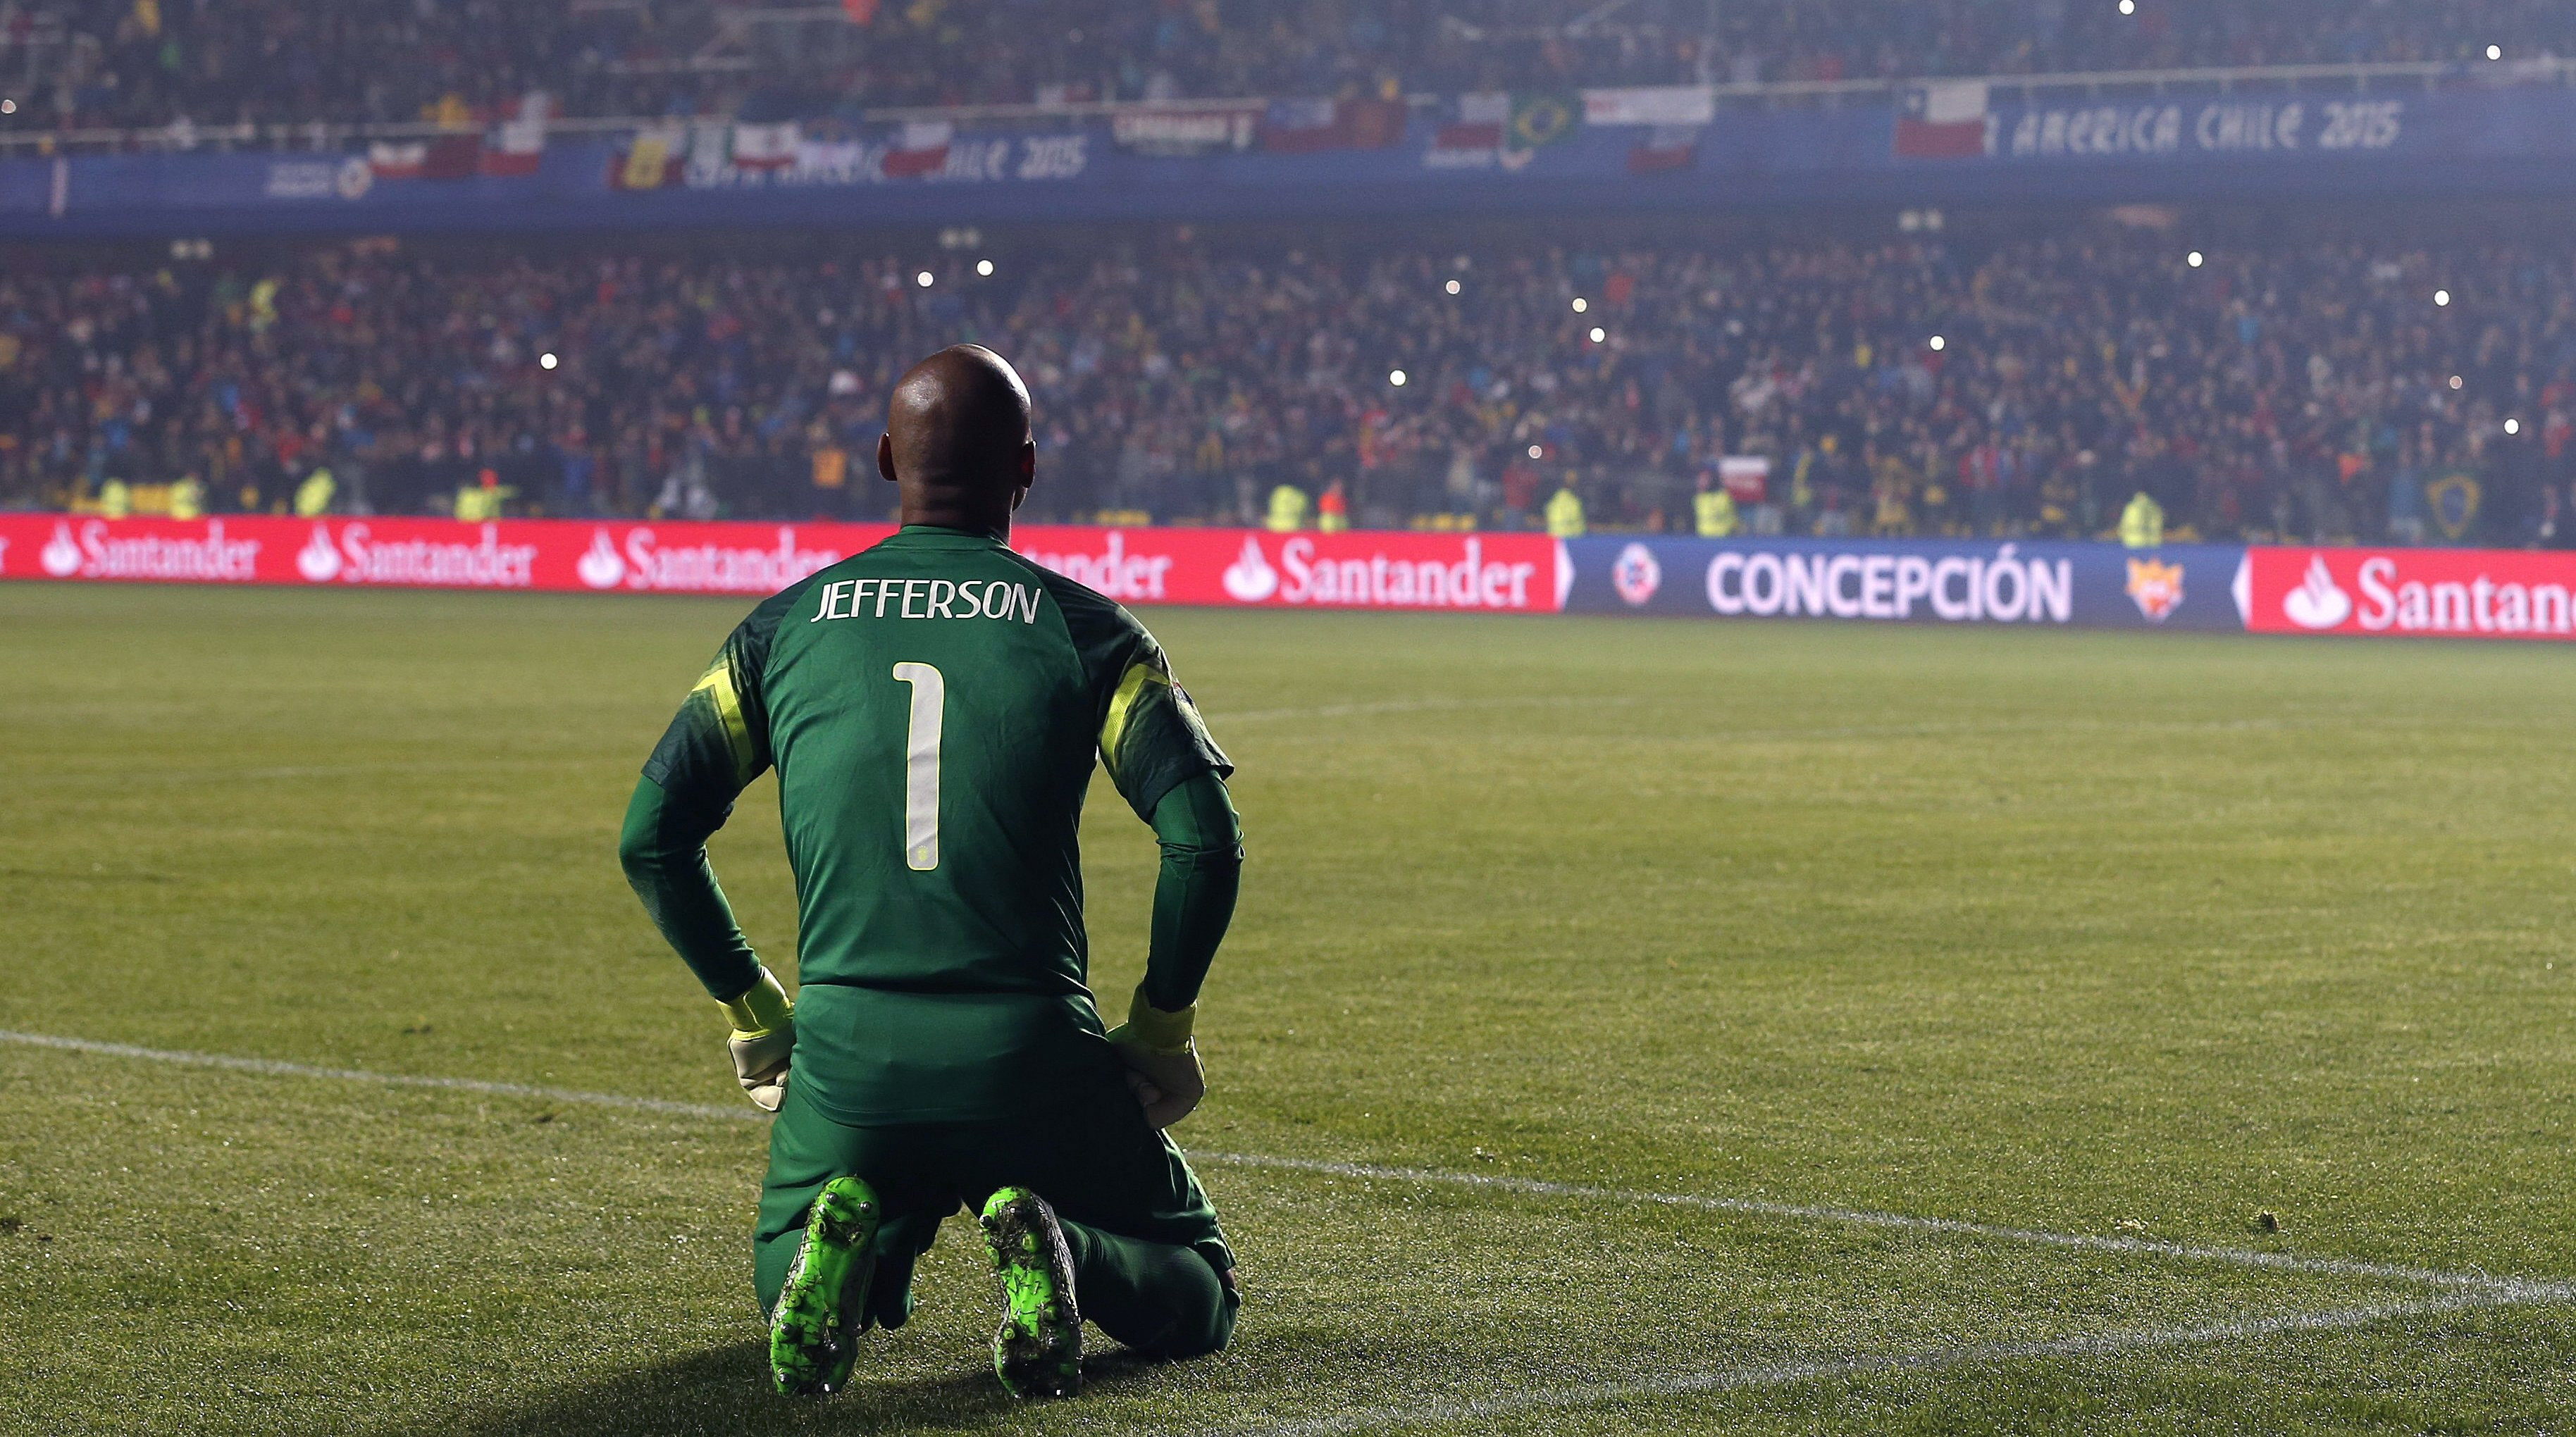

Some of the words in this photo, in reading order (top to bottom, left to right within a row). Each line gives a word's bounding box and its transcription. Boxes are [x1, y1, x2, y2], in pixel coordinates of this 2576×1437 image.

[2317, 101, 2401, 148] 2015
[81, 518, 259, 579] Santander
[341, 522, 537, 587] Santander
[1280, 536, 1535, 607] Santander
[810, 578, 1041, 625] JEFFERSON
[1706, 544, 2072, 622] CONCEPCIÓN
[2358, 557, 2576, 633] Santan
[892, 661, 944, 871] 1
